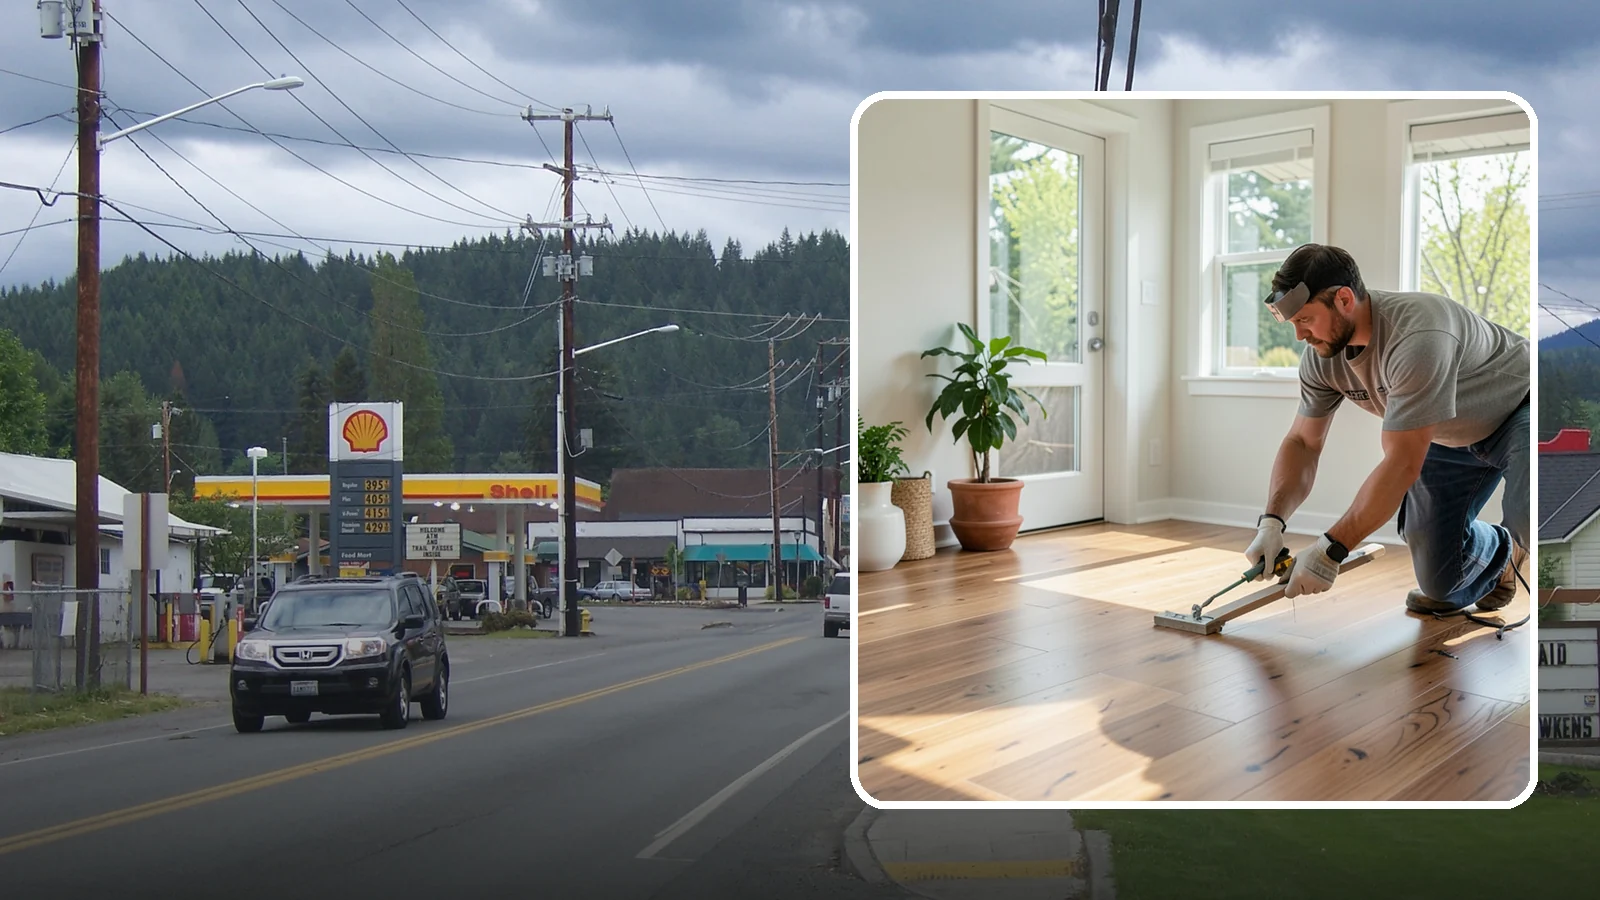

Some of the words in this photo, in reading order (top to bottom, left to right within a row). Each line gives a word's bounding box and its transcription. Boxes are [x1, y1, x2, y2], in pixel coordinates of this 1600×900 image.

[366, 480, 383, 490] 395
[490, 484, 547, 499] Shell
[366, 494, 383, 504] 405
[366, 508, 383, 518] 415
[366, 522, 383, 532] 429
[1538, 643, 1566, 665] AID
